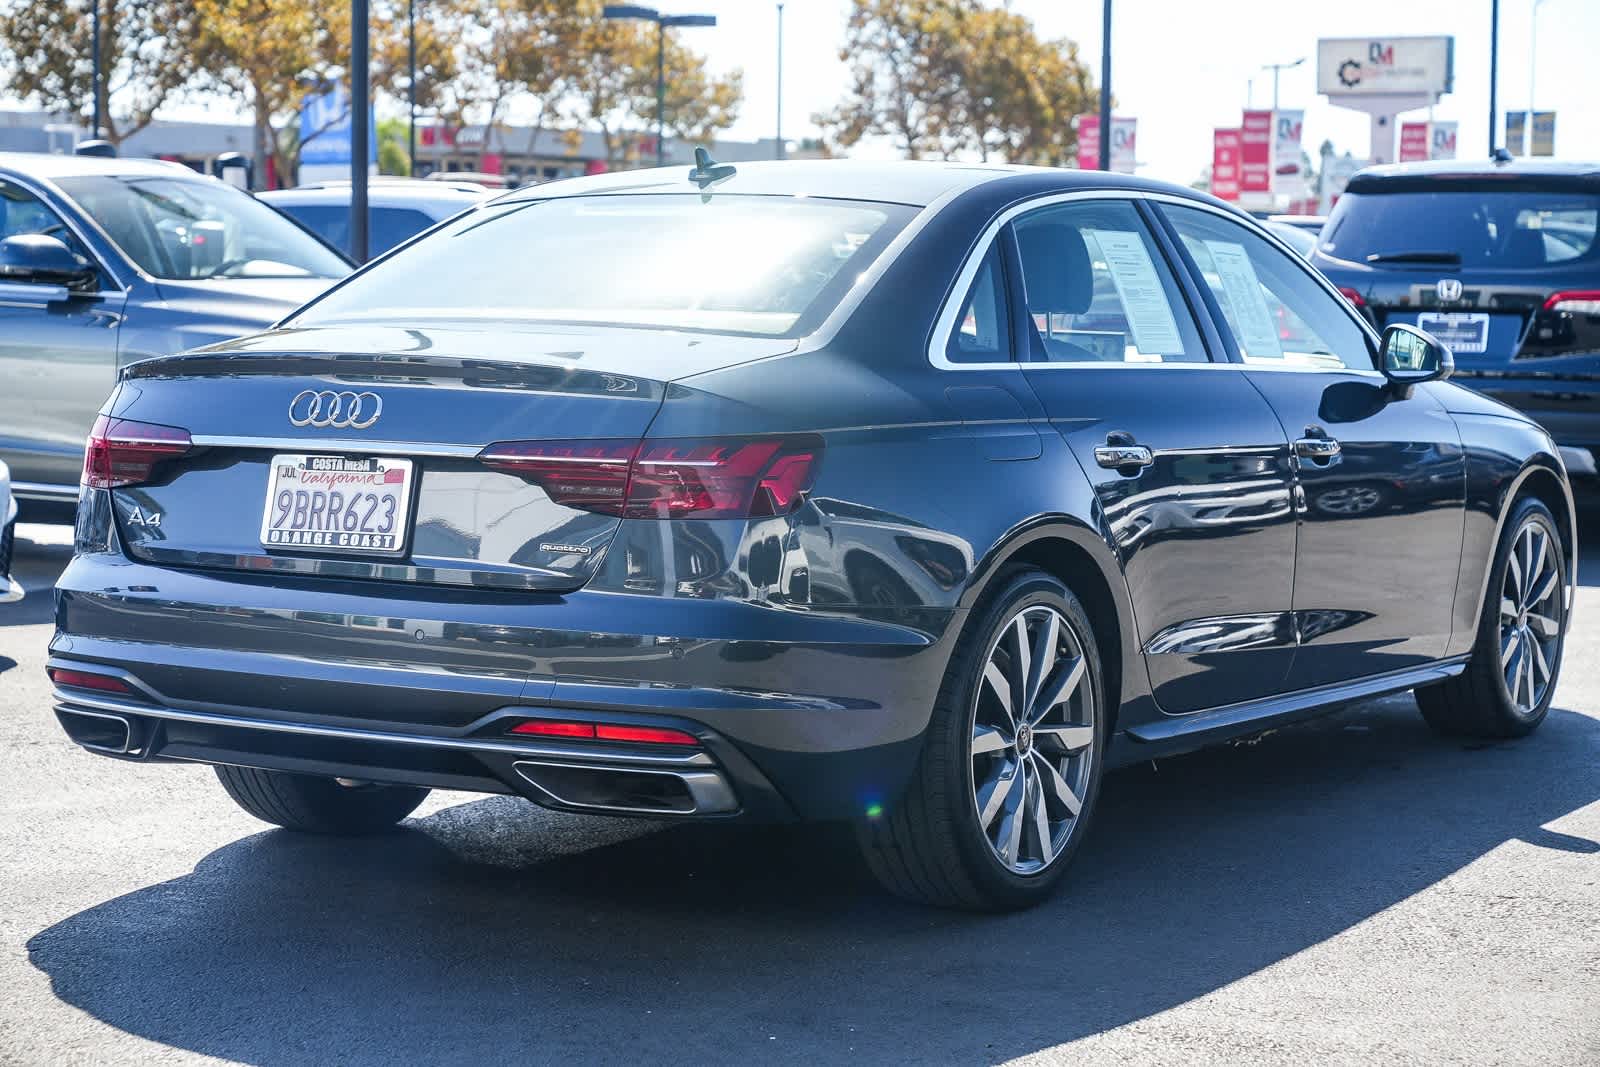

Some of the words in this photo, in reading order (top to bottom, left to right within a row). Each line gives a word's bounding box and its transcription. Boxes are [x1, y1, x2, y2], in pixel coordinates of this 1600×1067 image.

[282, 467, 297, 478] JUL
[313, 458, 344, 471] COSTA
[344, 459, 370, 472] MESA
[300, 471, 376, 490] California
[127, 506, 161, 527] A4
[273, 489, 397, 534] 9BRR623
[270, 531, 333, 545] ORANGE
[339, 534, 393, 547] COAST
[542, 544, 588, 553] quattro
